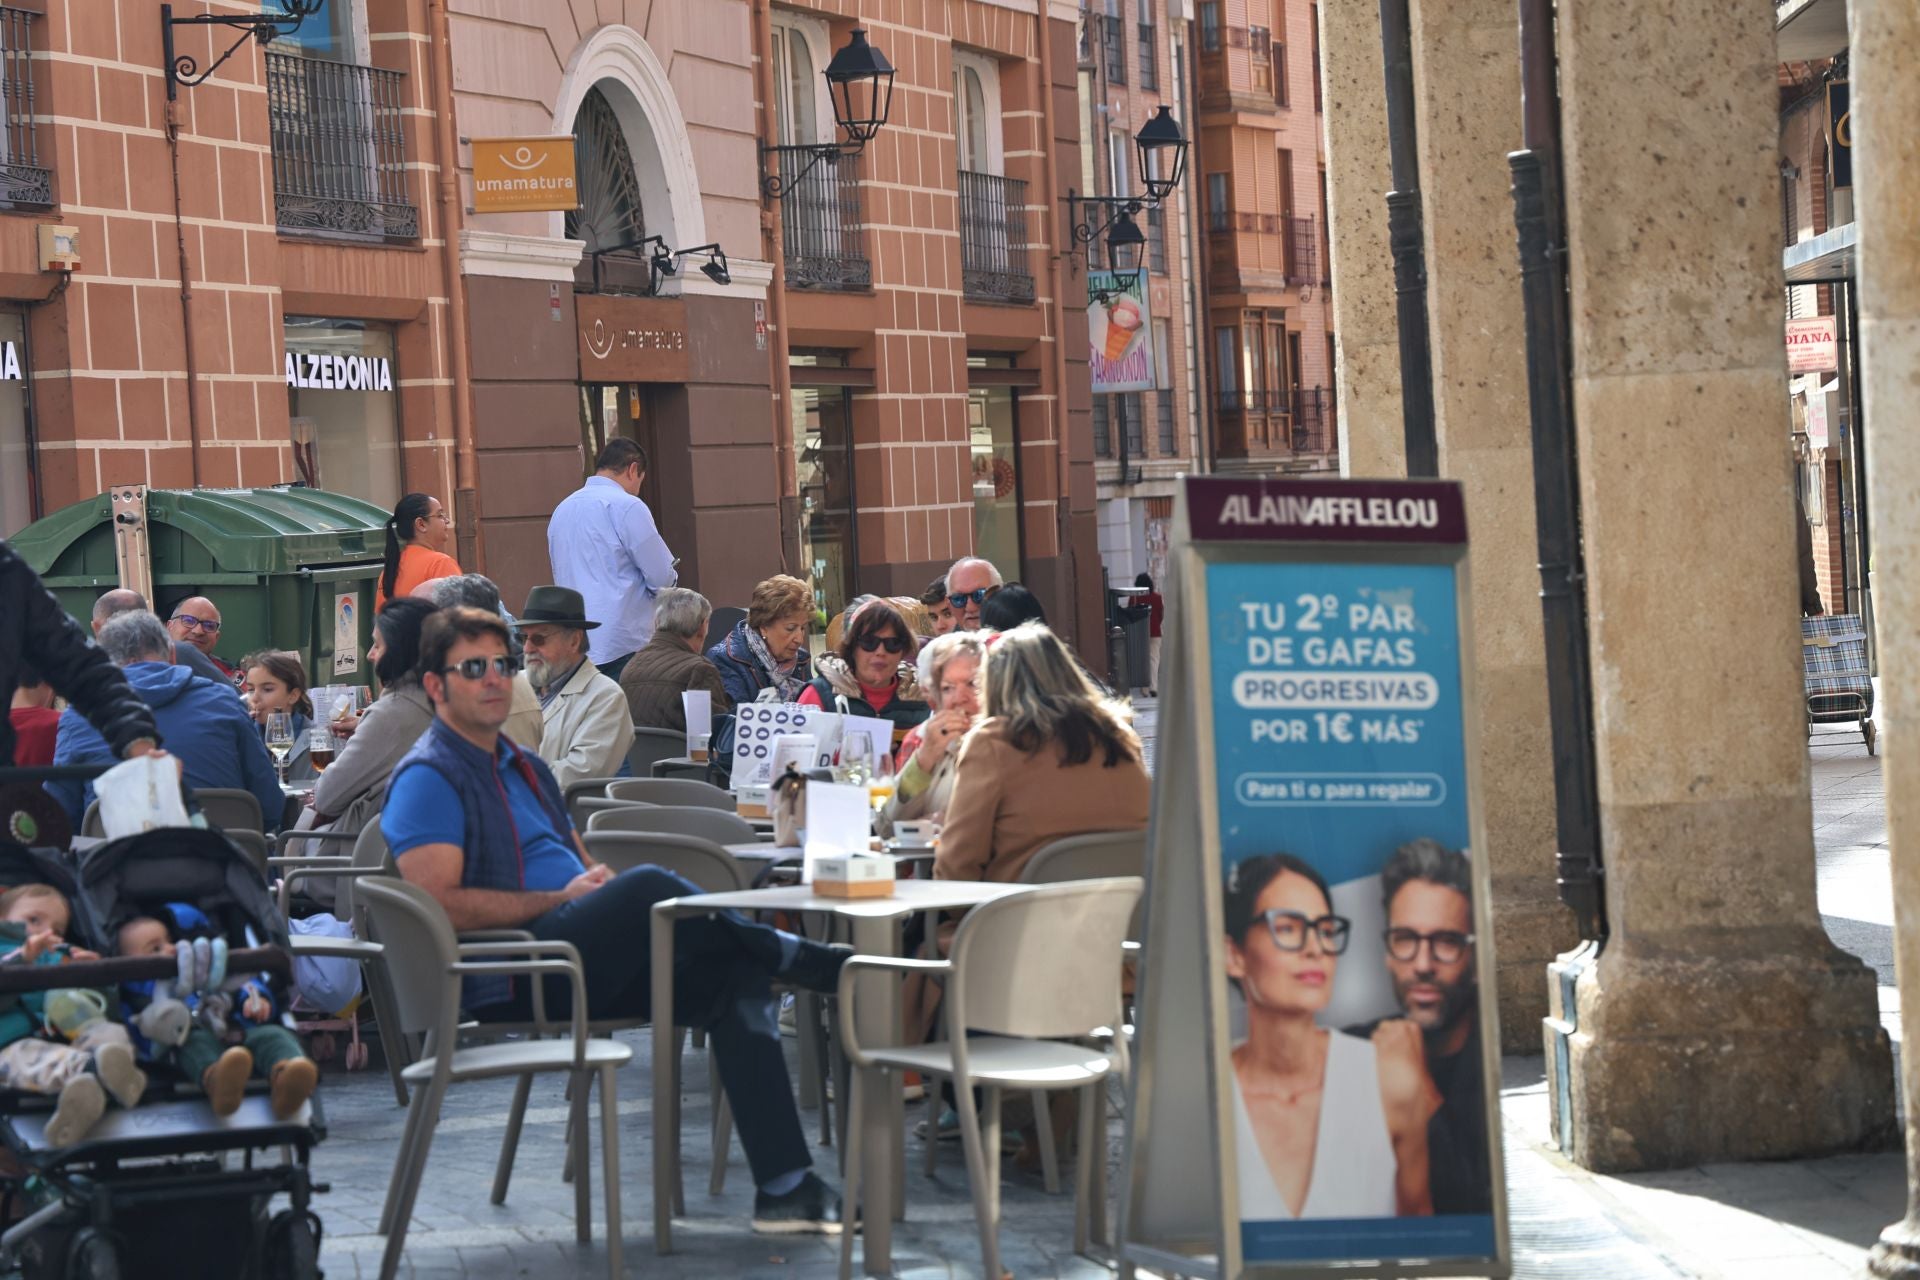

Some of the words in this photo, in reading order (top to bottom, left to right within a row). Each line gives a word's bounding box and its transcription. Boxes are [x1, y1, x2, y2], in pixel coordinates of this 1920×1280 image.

[476, 176, 574, 192] umamatura
[1240, 602, 1285, 631] TU
[1349, 603, 1415, 631] PAR
[1248, 636, 1295, 665] DE
[1303, 636, 1416, 667] GAFAS
[1243, 679, 1430, 701] PROGRESIVAS
[1250, 719, 1309, 743] POR
[1313, 712, 1354, 743] 1€
[1247, 780, 1288, 798] Para
[1291, 781, 1305, 798] ti
[1308, 784, 1322, 798] o
[1325, 784, 1366, 801] para
[1369, 781, 1432, 801] regalar
